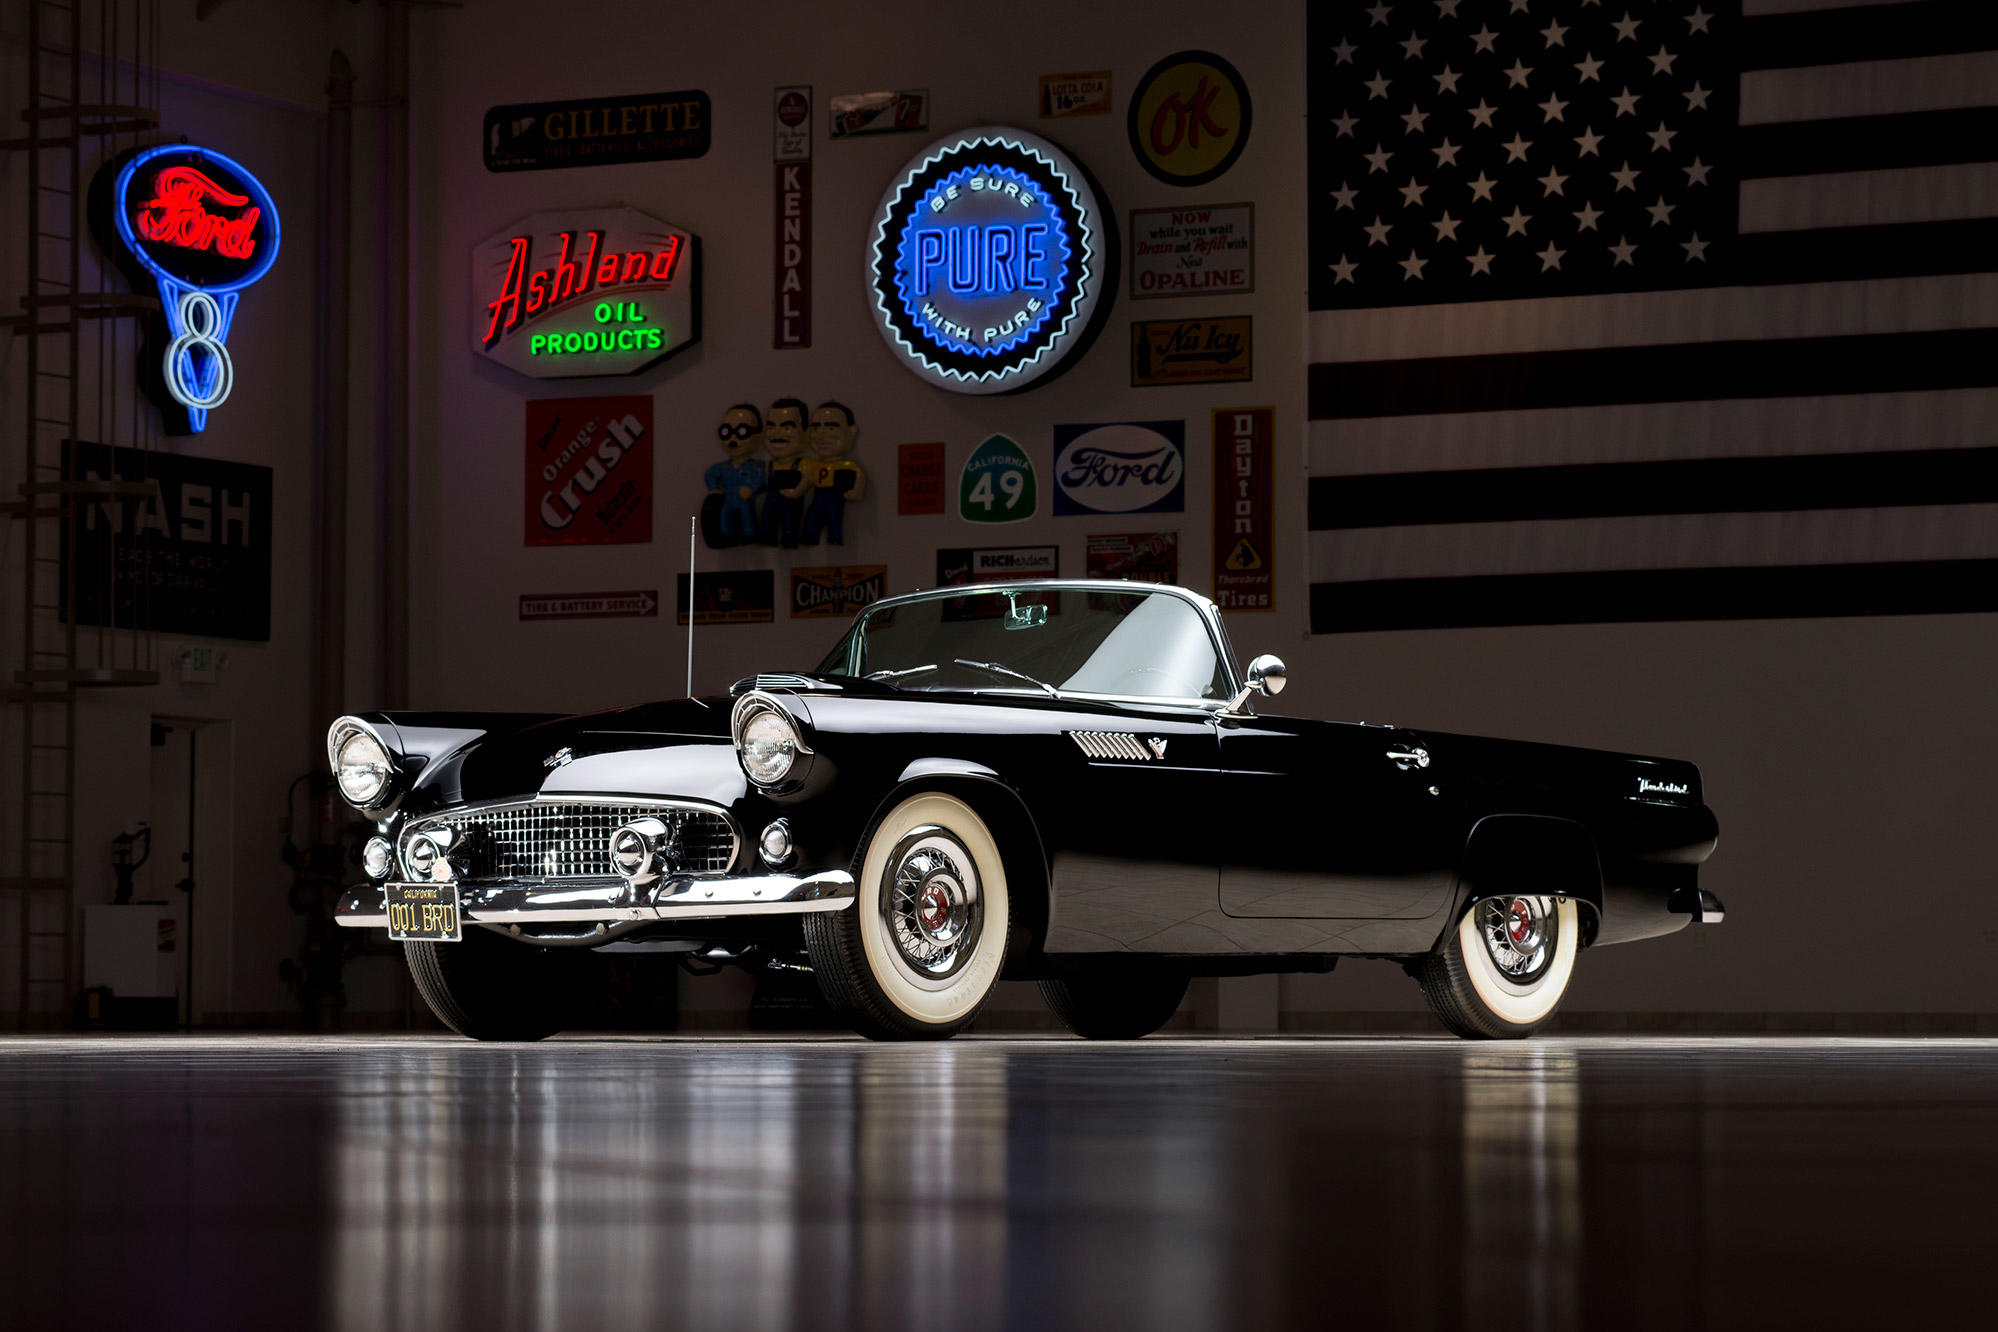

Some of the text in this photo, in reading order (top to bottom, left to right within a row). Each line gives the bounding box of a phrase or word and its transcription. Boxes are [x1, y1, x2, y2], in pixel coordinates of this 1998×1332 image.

[543, 100, 702, 141] GILLETTE
[1150, 76, 1228, 156] OK
[138, 165, 261, 260] Ford
[929, 176, 1036, 214] BE SURE
[1150, 223, 1233, 240] while you wait
[1172, 211, 1211, 225] NOW
[782, 166, 802, 343] KENDALL
[914, 224, 1050, 297] PURE
[1136, 241, 1173, 256] Drain
[1192, 235, 1228, 256] Refill
[1227, 237, 1248, 250] with
[483, 231, 685, 352] Ashland
[1139, 269, 1246, 291] OPALINE
[594, 301, 646, 324] OIL
[920, 296, 1043, 344] WITH PURE
[530, 327, 665, 356] PRODUCTS
[1155, 323, 1202, 355] Nu
[542, 418, 601, 482] Orange
[967, 455, 1030, 473] CALIFORNIA
[1061, 446, 1176, 489] Ford
[539, 412, 646, 530] Crush
[1233, 413, 1255, 535] Dayton
[968, 471, 1024, 512] 49
[526, 602, 549, 614] TIRE
[559, 600, 604, 612] BATTERY
[606, 598, 647, 611] SERVICE
[795, 577, 880, 607] CHAMPION
[1217, 589, 1269, 609] Tires
[403, 889, 438, 900] CALIFORNIA
[391, 903, 455, 932] 001 BRD
